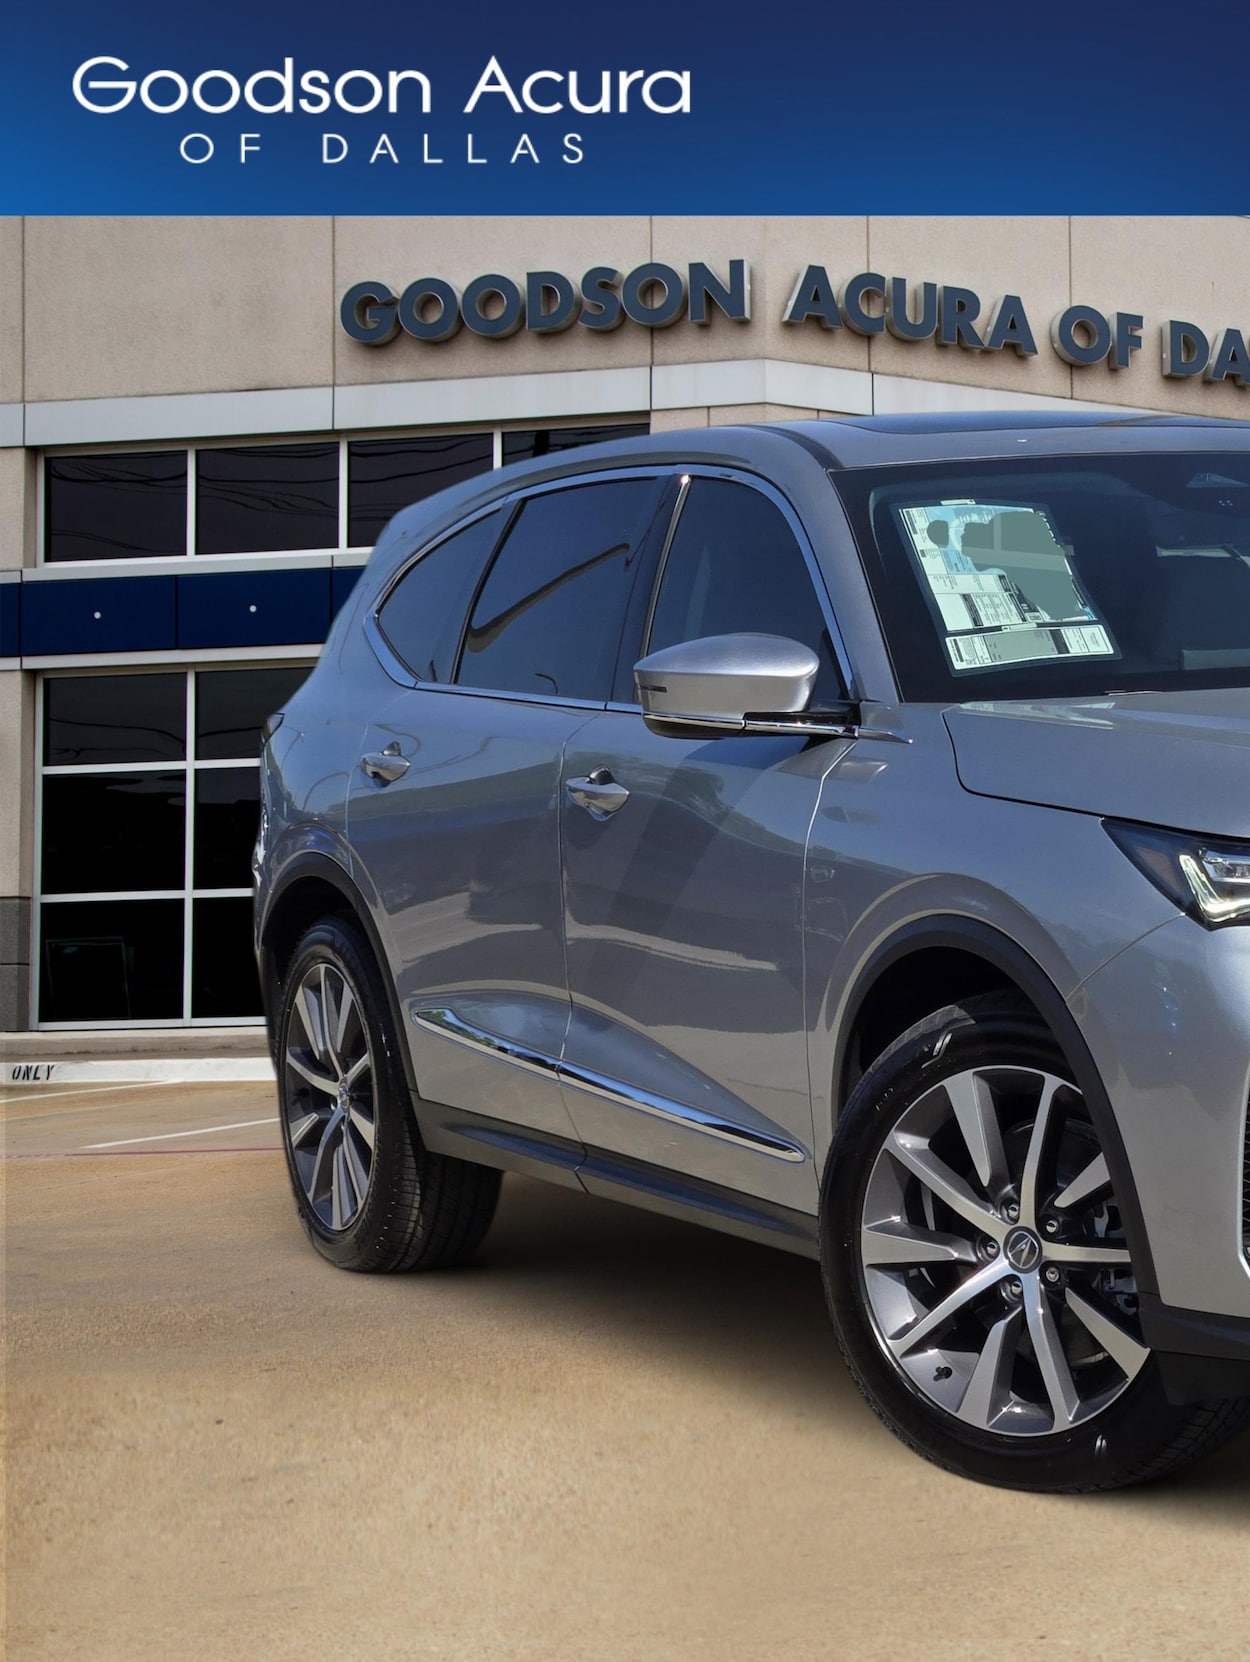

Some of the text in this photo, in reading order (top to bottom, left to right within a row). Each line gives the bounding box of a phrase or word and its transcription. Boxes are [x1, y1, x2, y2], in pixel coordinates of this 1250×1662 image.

[340, 258, 751, 346] GOODSON
[783, 265, 1038, 357] ACURA
[1051, 305, 1144, 370] OF
[11, 1064, 55, 1081] ONLY
